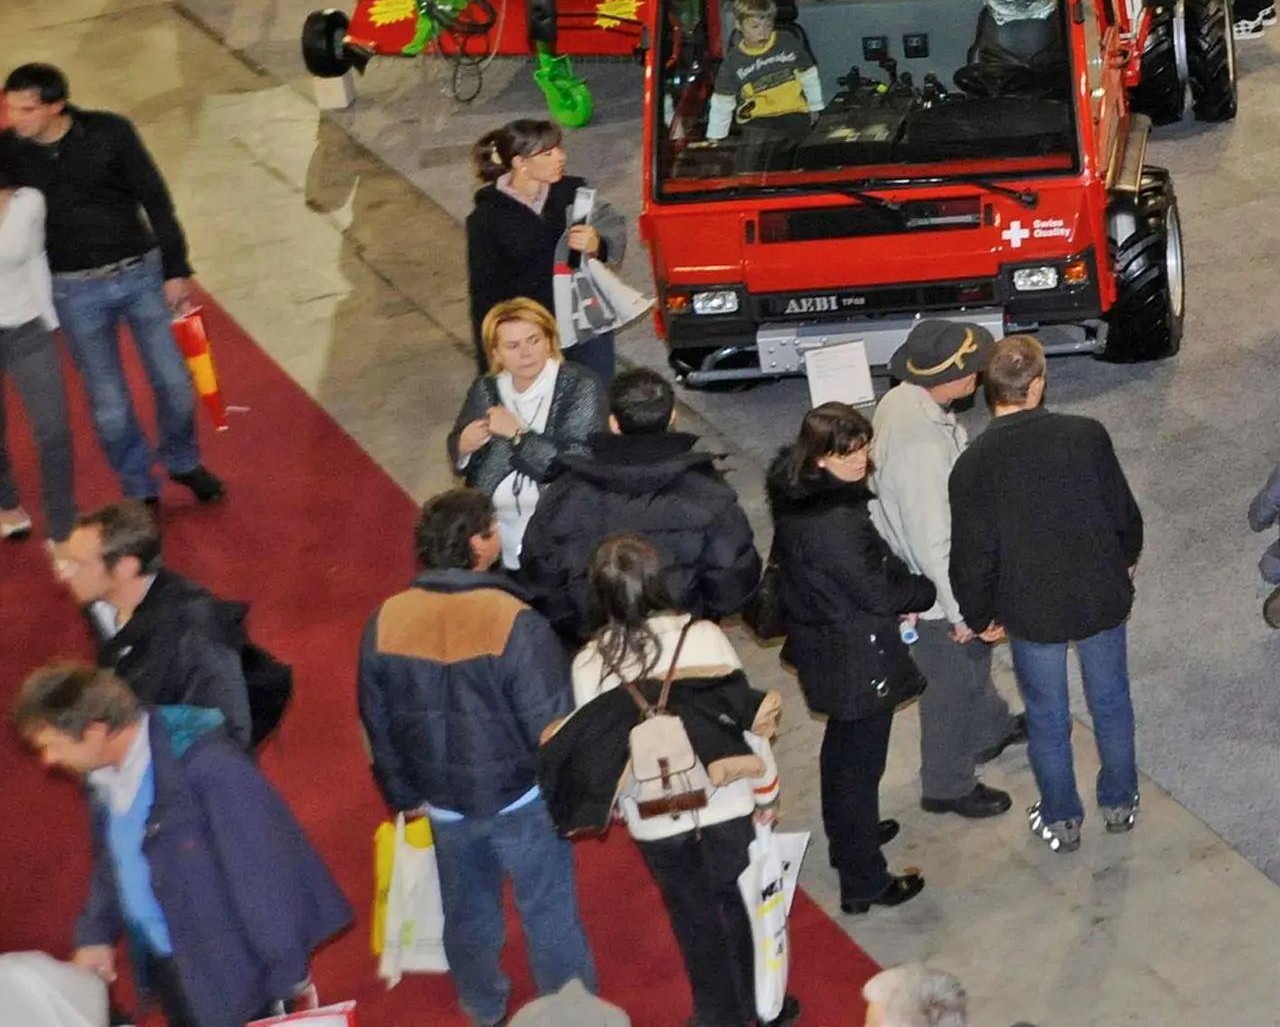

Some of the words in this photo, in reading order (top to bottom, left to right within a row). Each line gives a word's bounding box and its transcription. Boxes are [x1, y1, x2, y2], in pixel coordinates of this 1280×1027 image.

[1033, 218, 1064, 228] Swiss
[1033, 226, 1071, 238] Quality
[784, 295, 838, 314] AEBI
